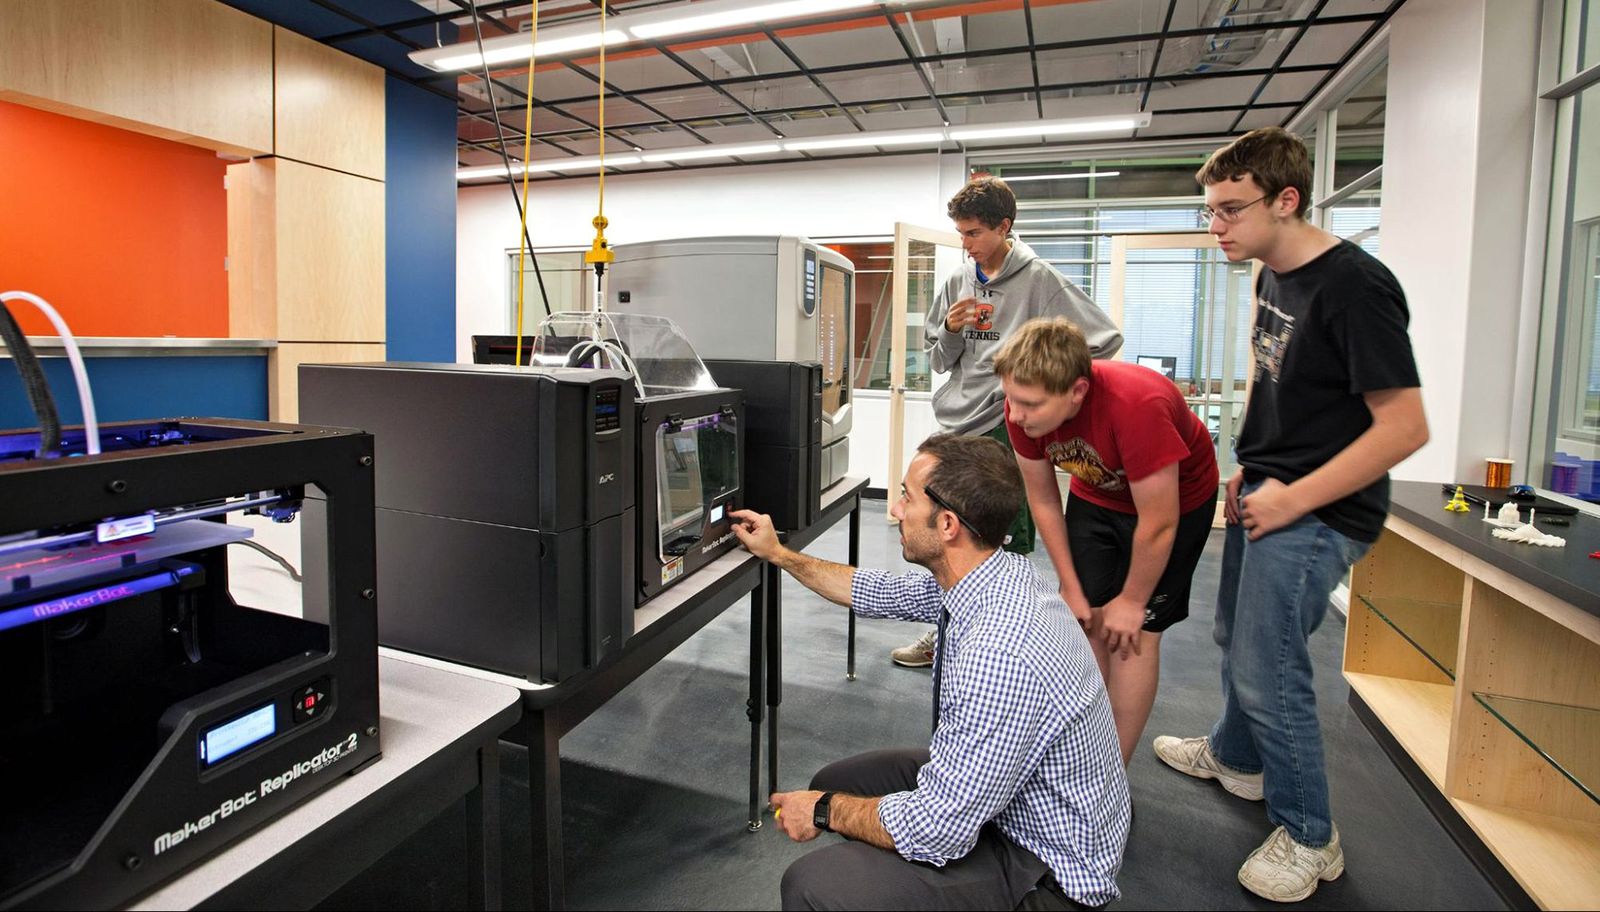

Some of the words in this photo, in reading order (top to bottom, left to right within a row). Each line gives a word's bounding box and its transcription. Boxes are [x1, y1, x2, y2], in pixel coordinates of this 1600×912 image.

[964, 330, 1000, 341] TENNIS
[599, 473, 614, 485] APC
[32, 586, 132, 617] MakerBot
[153, 790, 257, 856] MakerBot
[260, 742, 343, 798] Replicator
[347, 732, 358, 750] 2
